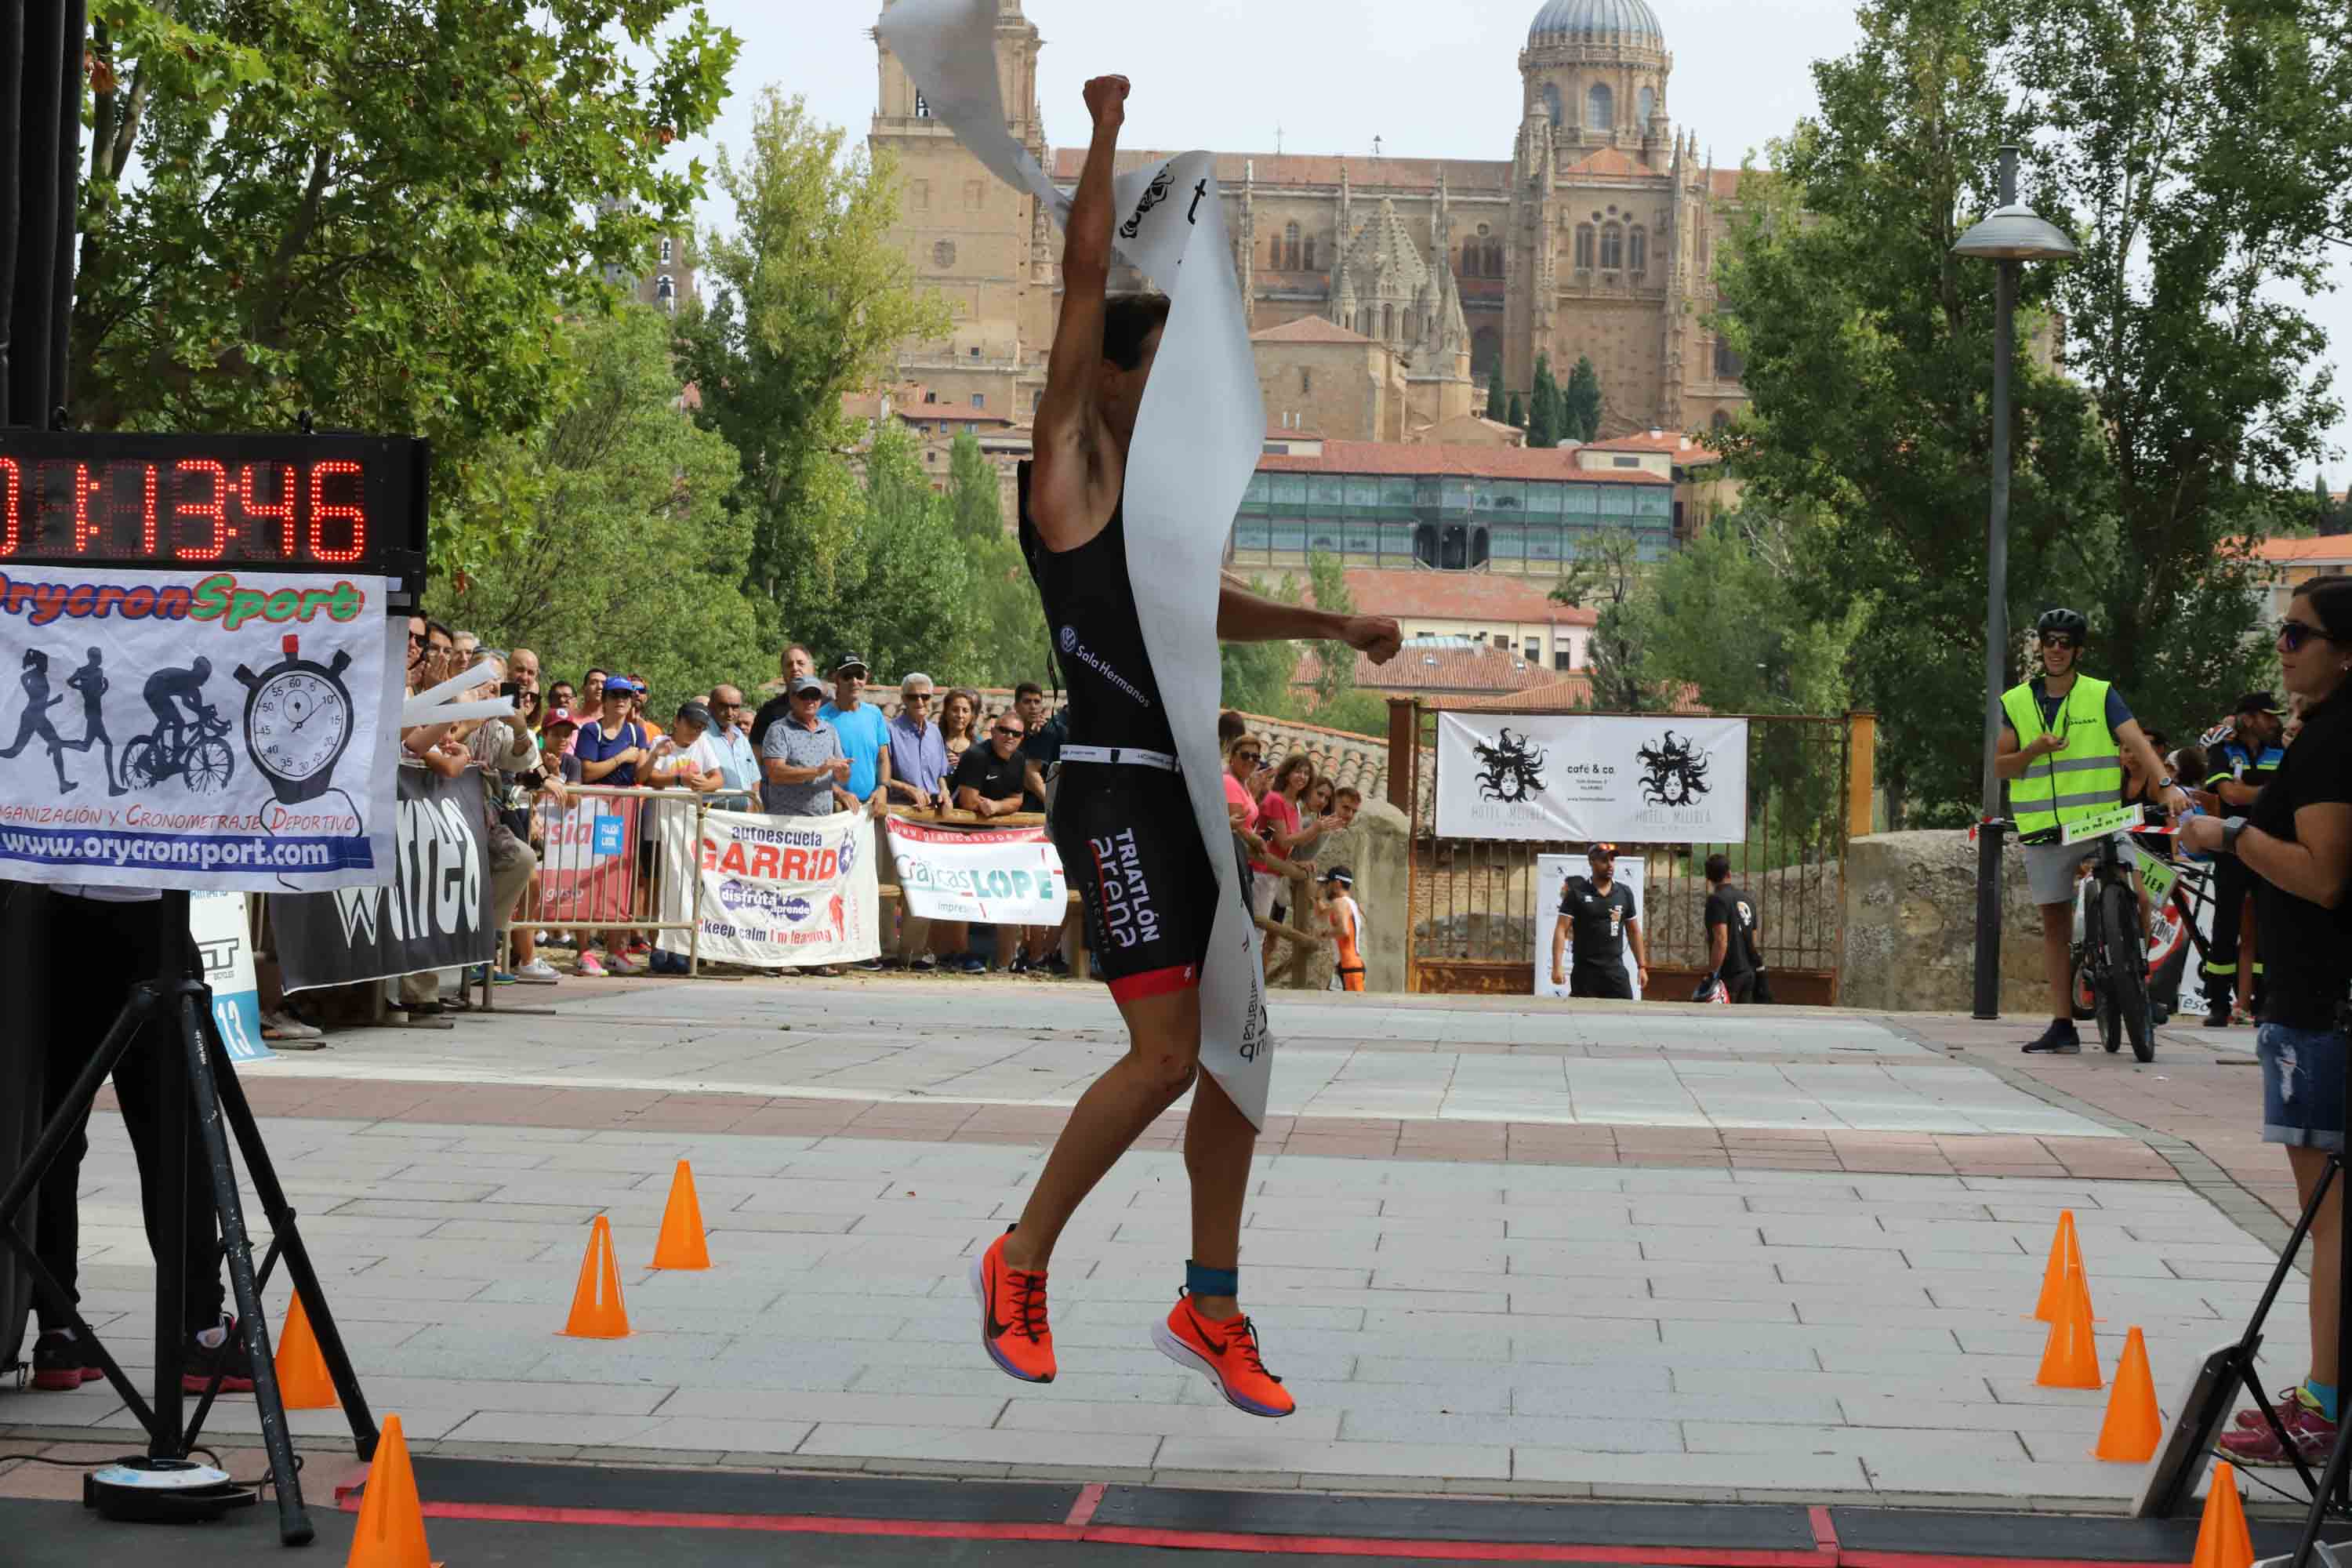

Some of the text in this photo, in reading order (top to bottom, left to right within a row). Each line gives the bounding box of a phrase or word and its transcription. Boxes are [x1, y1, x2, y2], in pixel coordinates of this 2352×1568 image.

[289, 677, 301, 688] 60
[1076, 644, 1150, 707] Sala Hermanos
[272, 686, 284, 697] 55
[322, 695, 334, 704] 10
[263, 702, 274, 712] 50
[267, 745, 278, 753] 40
[281, 757, 292, 767] 35
[271, 807, 356, 830] DEPORTIVO
[731, 826, 822, 848] autoescuela
[2, 833, 329, 869] www.orycronsport.com
[1091, 837, 1137, 948] arena
[1116, 828, 1160, 943] TRIATLÓN
[721, 888, 777, 909] disfruta
[770, 903, 811, 916] aprende
[704, 920, 735, 938] keep
[739, 928, 766, 941] calm
[217, 999, 255, 1055] 13
